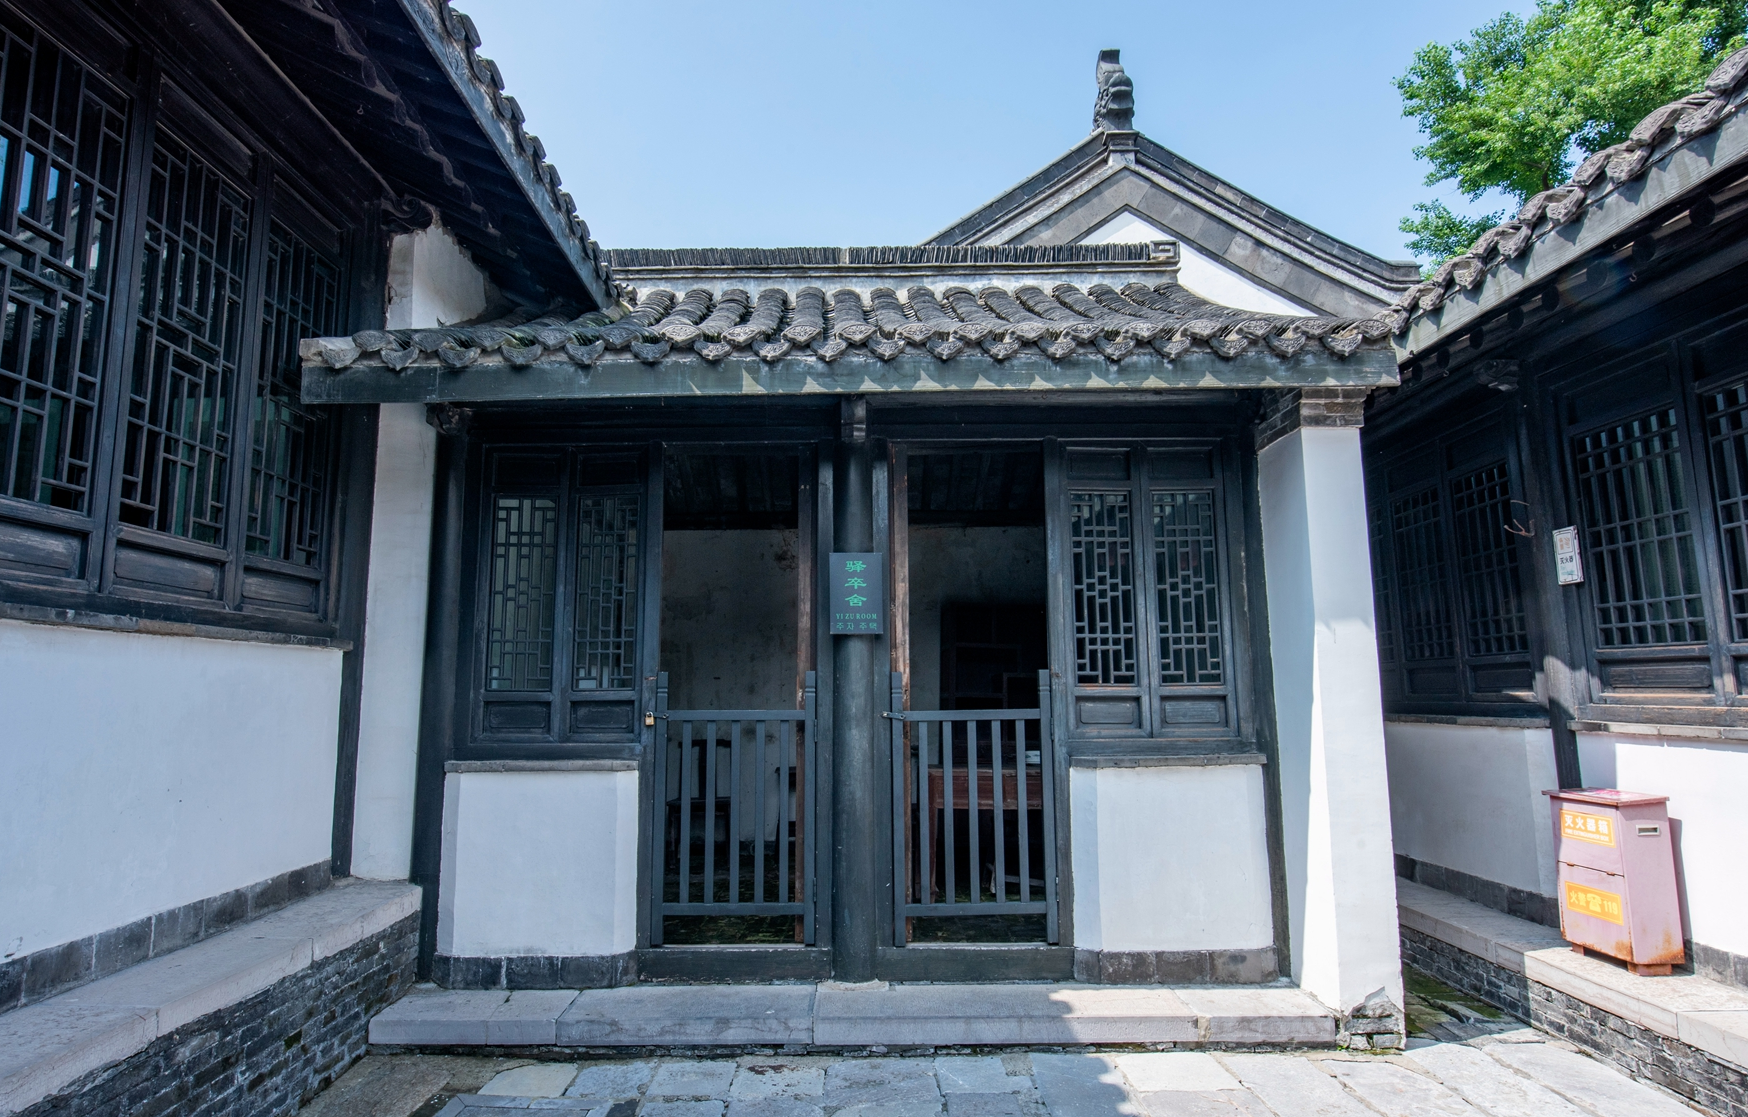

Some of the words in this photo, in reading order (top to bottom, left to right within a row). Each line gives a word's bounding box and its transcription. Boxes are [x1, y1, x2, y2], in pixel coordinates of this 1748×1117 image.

[844, 560, 867, 607] 驿卒舍
[1564, 814, 1609, 835] 灭火器箱
[1569, 890, 1586, 907] 火警
[1603, 900, 1618, 915] 119
